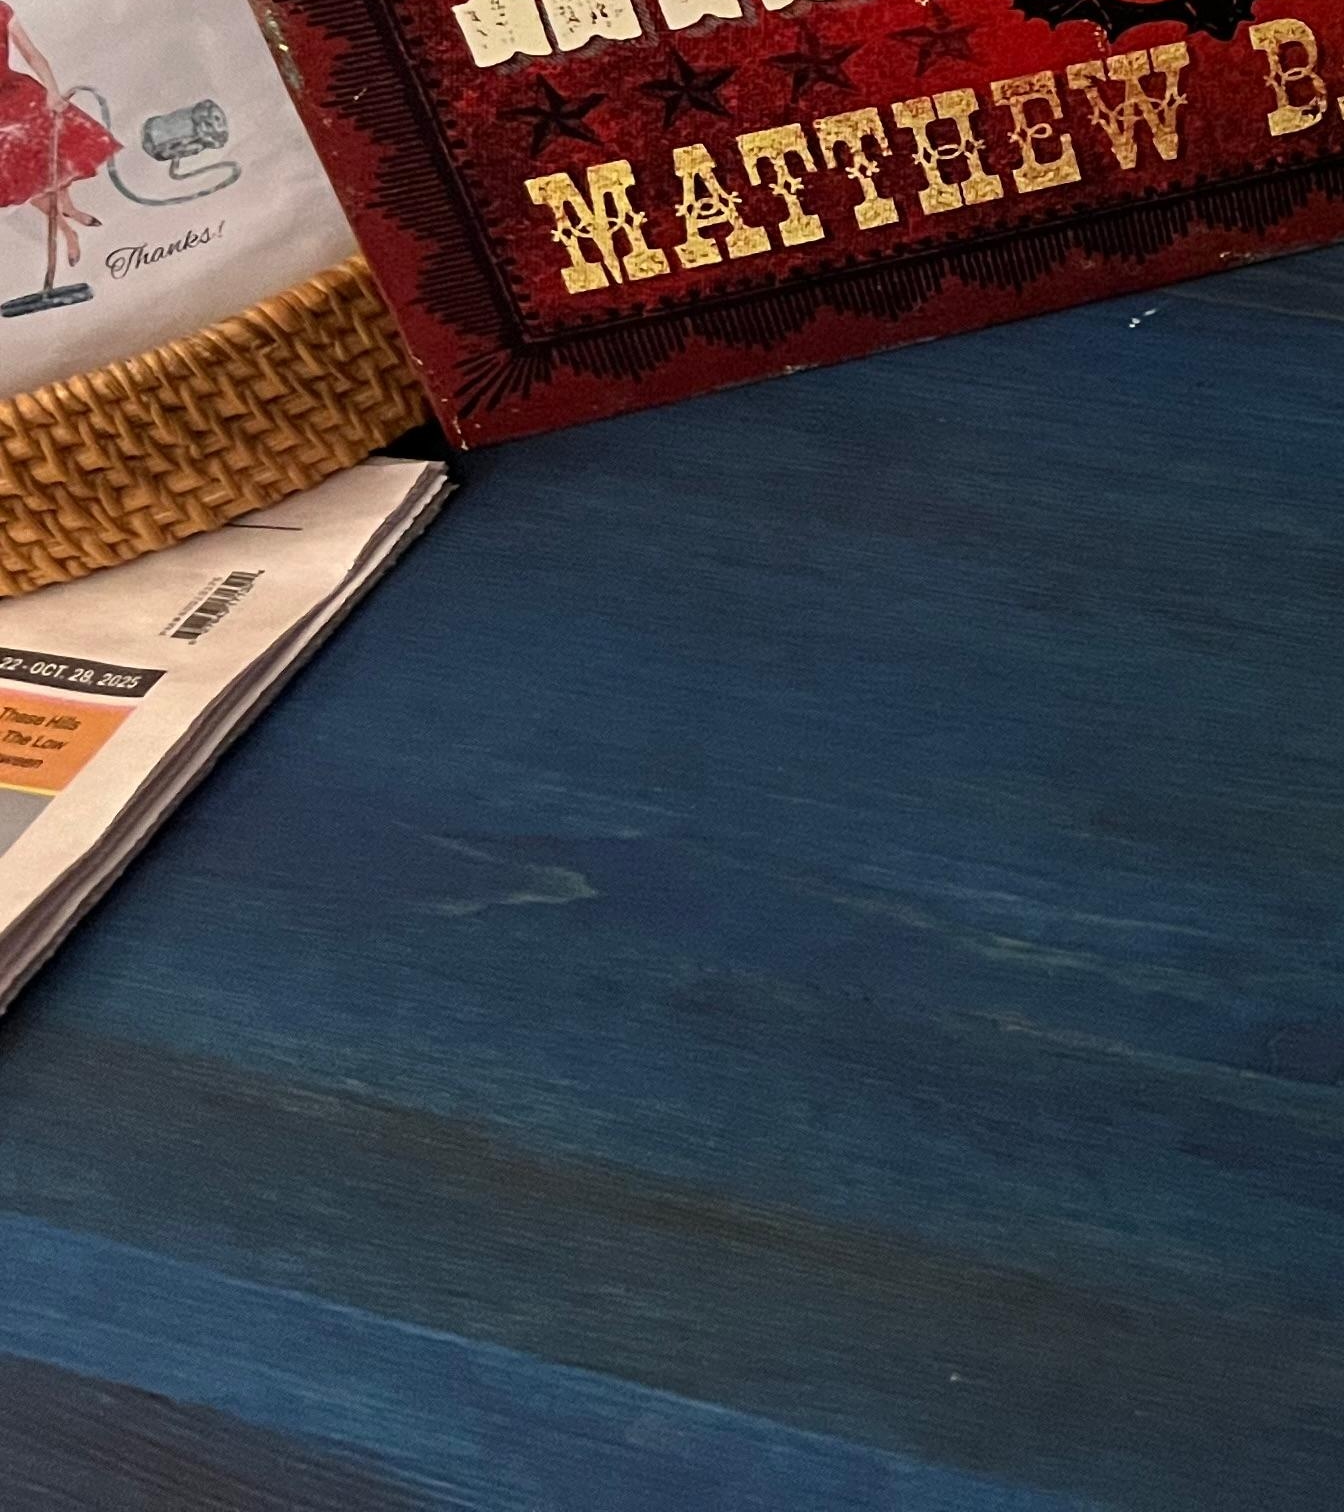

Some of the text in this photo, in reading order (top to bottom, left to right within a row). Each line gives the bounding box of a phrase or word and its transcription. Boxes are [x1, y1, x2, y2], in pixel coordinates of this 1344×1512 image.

[525, 42, 1190, 294] MATTHEW
[107, 220, 226, 280] Thanks!
[97, 673, 143, 689] 2025
